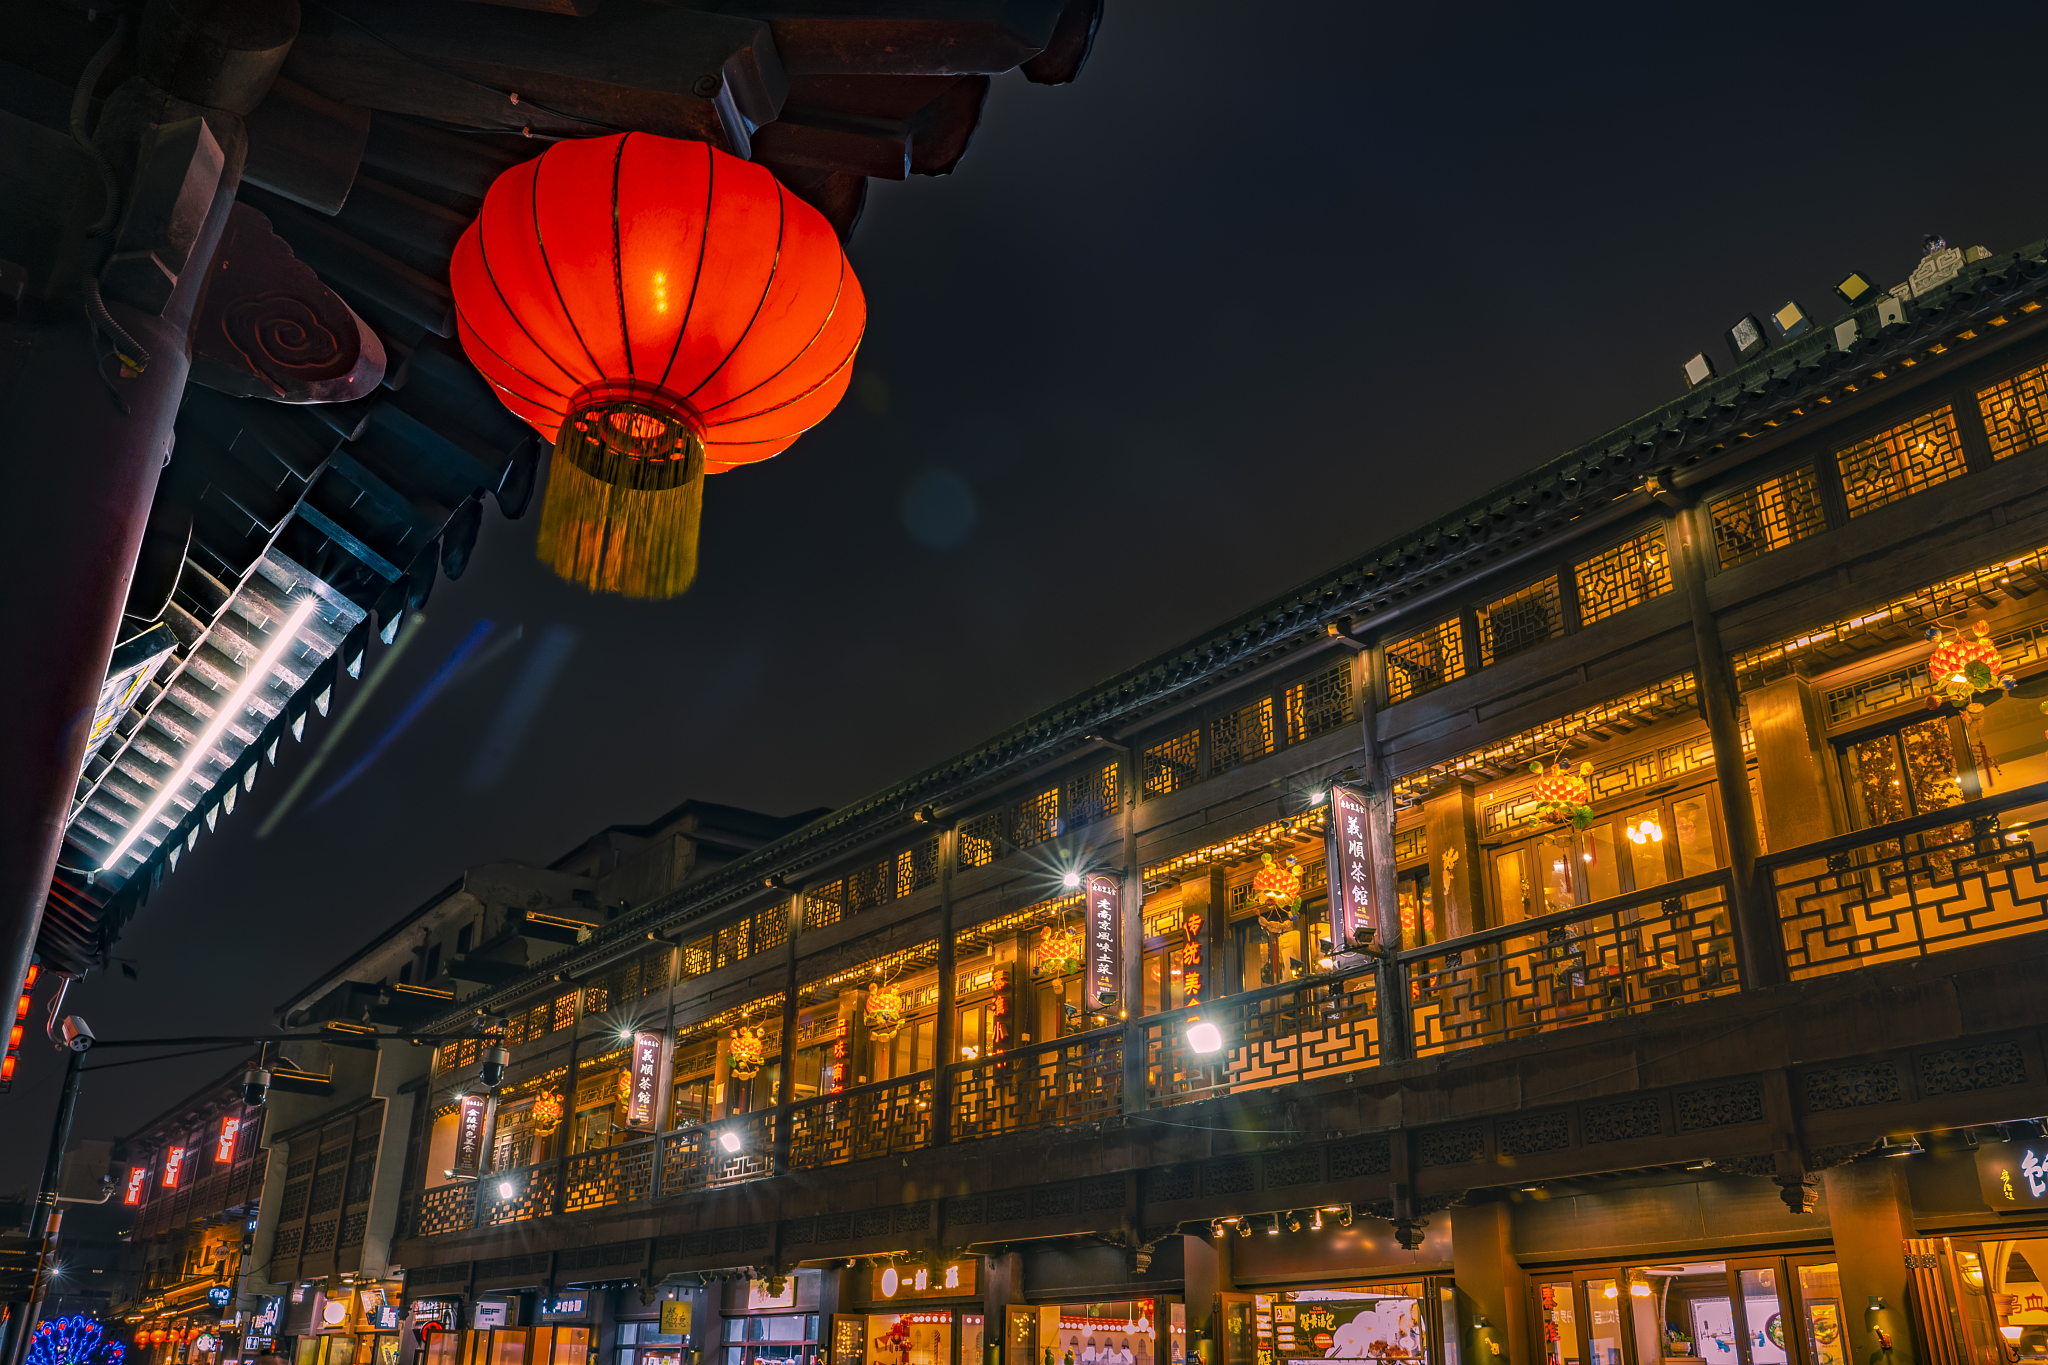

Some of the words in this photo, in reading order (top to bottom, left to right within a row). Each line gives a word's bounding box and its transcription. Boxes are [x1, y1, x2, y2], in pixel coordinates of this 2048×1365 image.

[1347, 816, 1368, 906] 義順茶館
[638, 1049, 654, 1104] 義順茶館
[463, 1109, 480, 1153] 金陵特色美食
